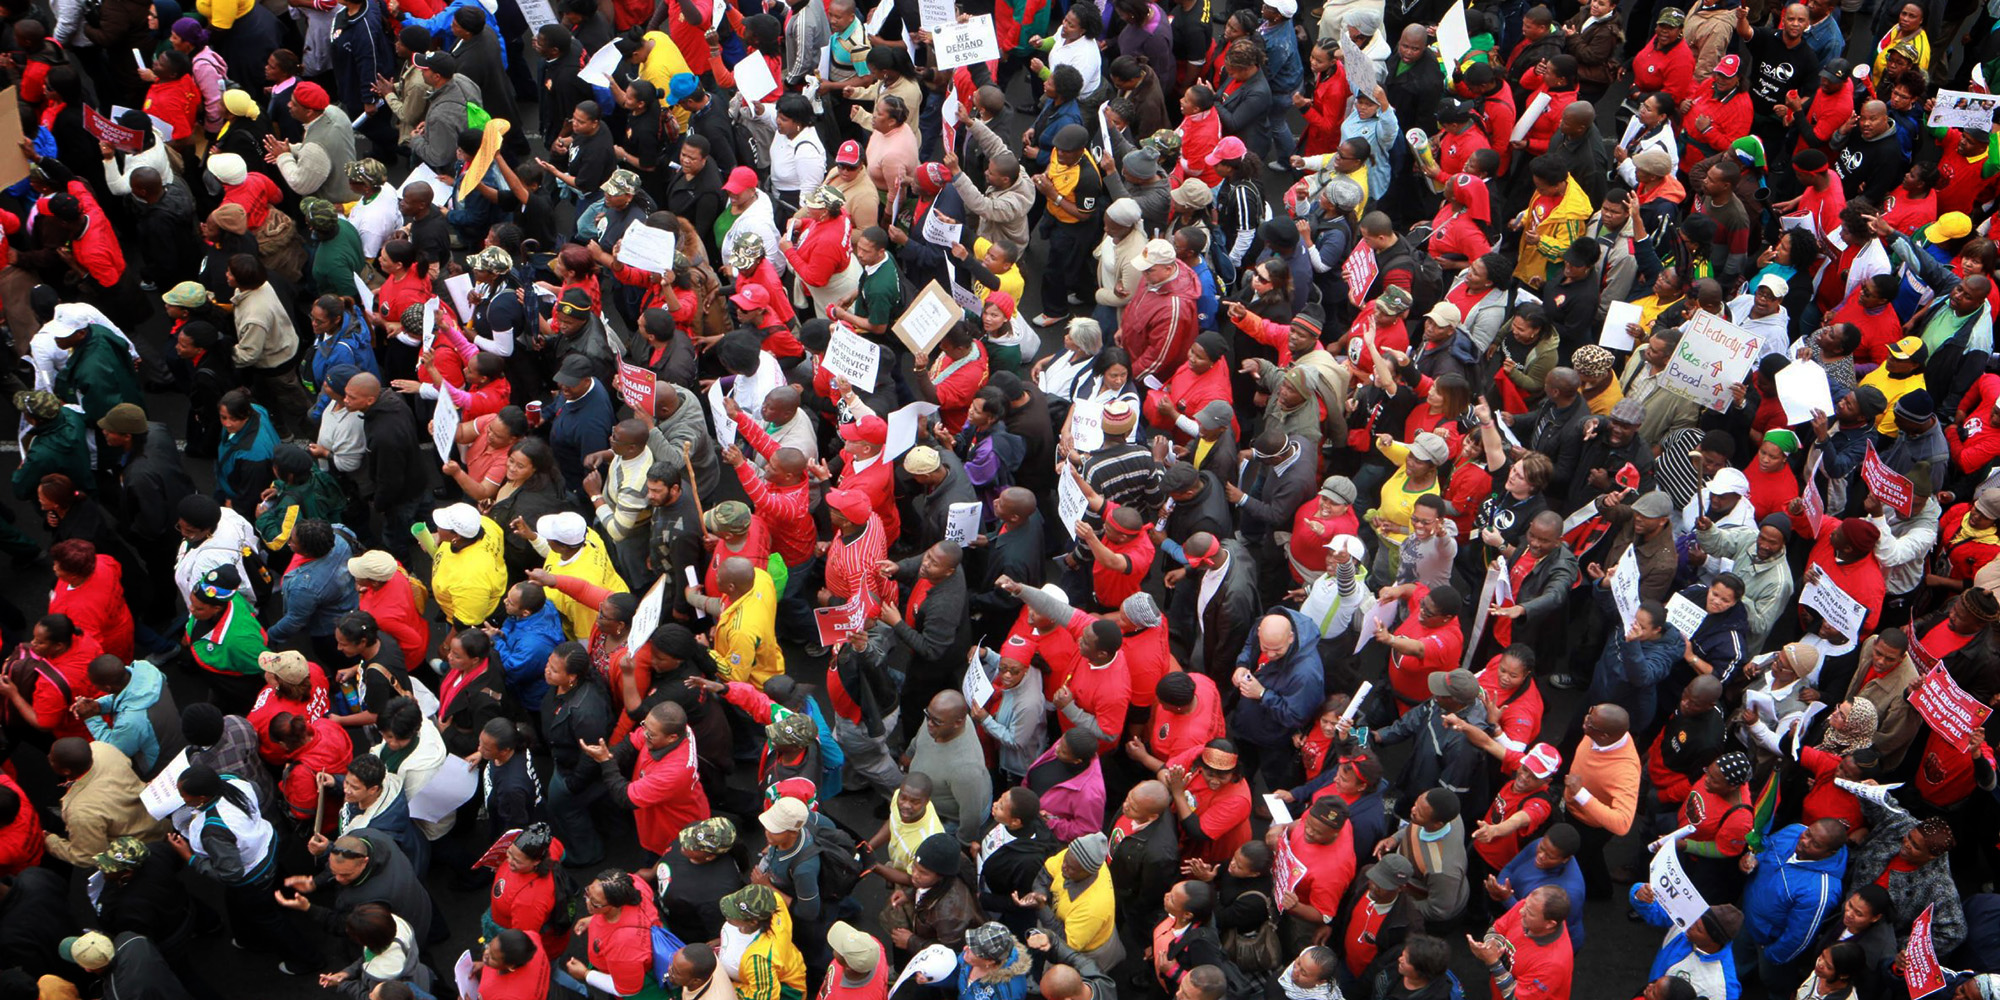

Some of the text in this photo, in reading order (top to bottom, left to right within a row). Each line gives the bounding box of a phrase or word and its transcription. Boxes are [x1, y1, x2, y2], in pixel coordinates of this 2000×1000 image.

[946, 40, 983, 53] DEMAND
[956, 33, 970, 42] WE
[955, 51, 978, 62] 8.5%
[831, 346, 870, 373] NO SERVICE
[838, 341, 875, 364] SETTLEMENT
[1678, 342, 1700, 367] Rates
[832, 357, 865, 380] DELIVERY
[1668, 362, 1702, 388] Bread
[1085, 418, 1098, 428] TO
[1883, 485, 1908, 502] TERM
[1813, 595, 1850, 630] OWNERSHIP
[1922, 683, 1973, 734] IMPLEMENTATION
[1930, 679, 1972, 724] WE DEMAND
[1918, 693, 1934, 713] DATE
[1941, 719, 1963, 740] APRIL
[1660, 874, 1680, 900] NO
[1666, 856, 1694, 902] TO 6.5%
[1914, 946, 1928, 984] MEDICAL
[1918, 938, 1930, 973] DEMAND
